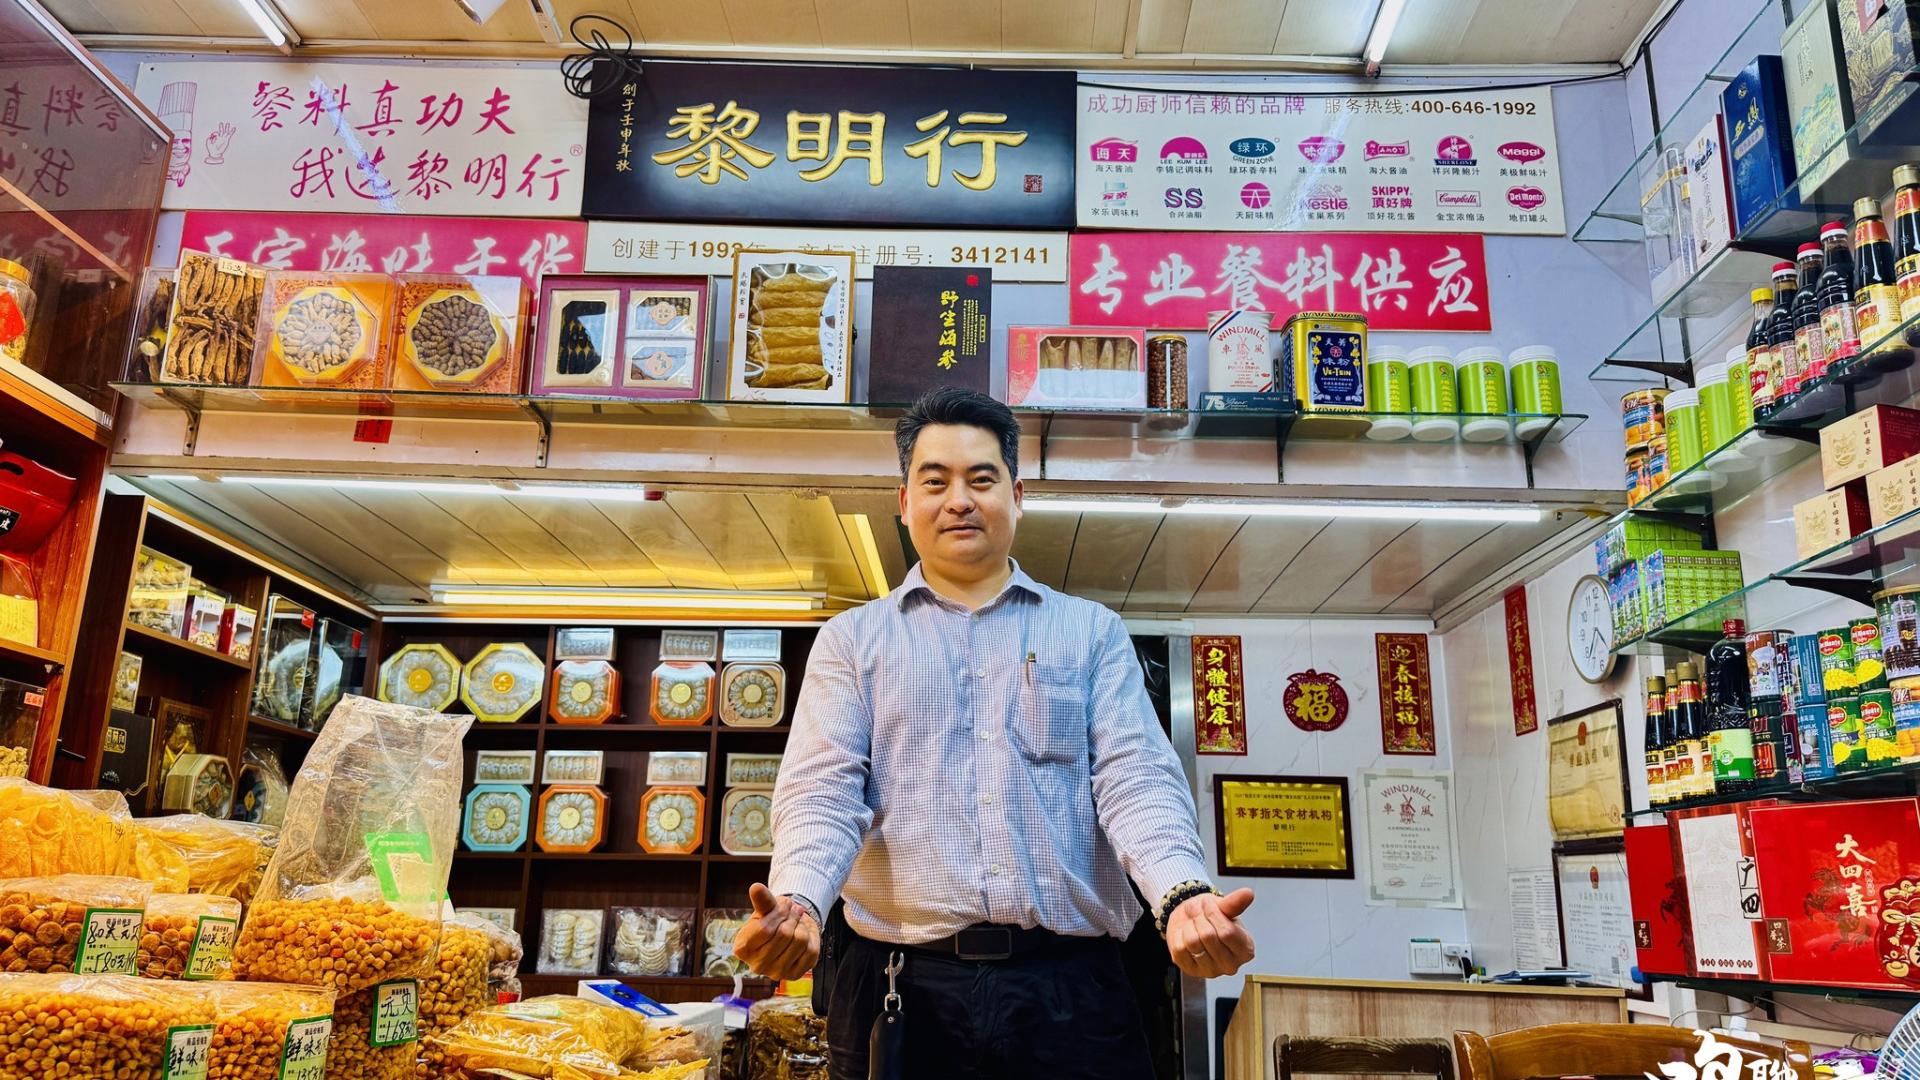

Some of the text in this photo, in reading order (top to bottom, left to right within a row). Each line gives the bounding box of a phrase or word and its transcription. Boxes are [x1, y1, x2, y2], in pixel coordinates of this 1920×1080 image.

[252, 79, 515, 136] 餐料真功夫
[1087, 93, 1306, 115] 成功厨师信赖的品牌
[615, 83, 637, 172] 創于壬申年秋
[651, 99, 1029, 192] 黎明行
[1237, 143, 1269, 153] 绿环
[1298, 166, 1347, 175] 味味精
[1164, 187, 1203, 209] SS
[1372, 186, 1410, 196] SKIPPY
[950, 246, 1050, 265] 3412141
[1080, 243, 1480, 316] 专业餐料供应
[1217, 325, 1267, 342] WINDMILL
[1205, 647, 1234, 726] 身體健康
[1390, 644, 1418, 726] 迎春接福
[1292, 682, 1337, 723] 福
[1380, 784, 1432, 802] WINDMILL
[1235, 806, 1333, 821] 赛事指定食材机构
[1835, 833, 1878, 918] 大四喜
